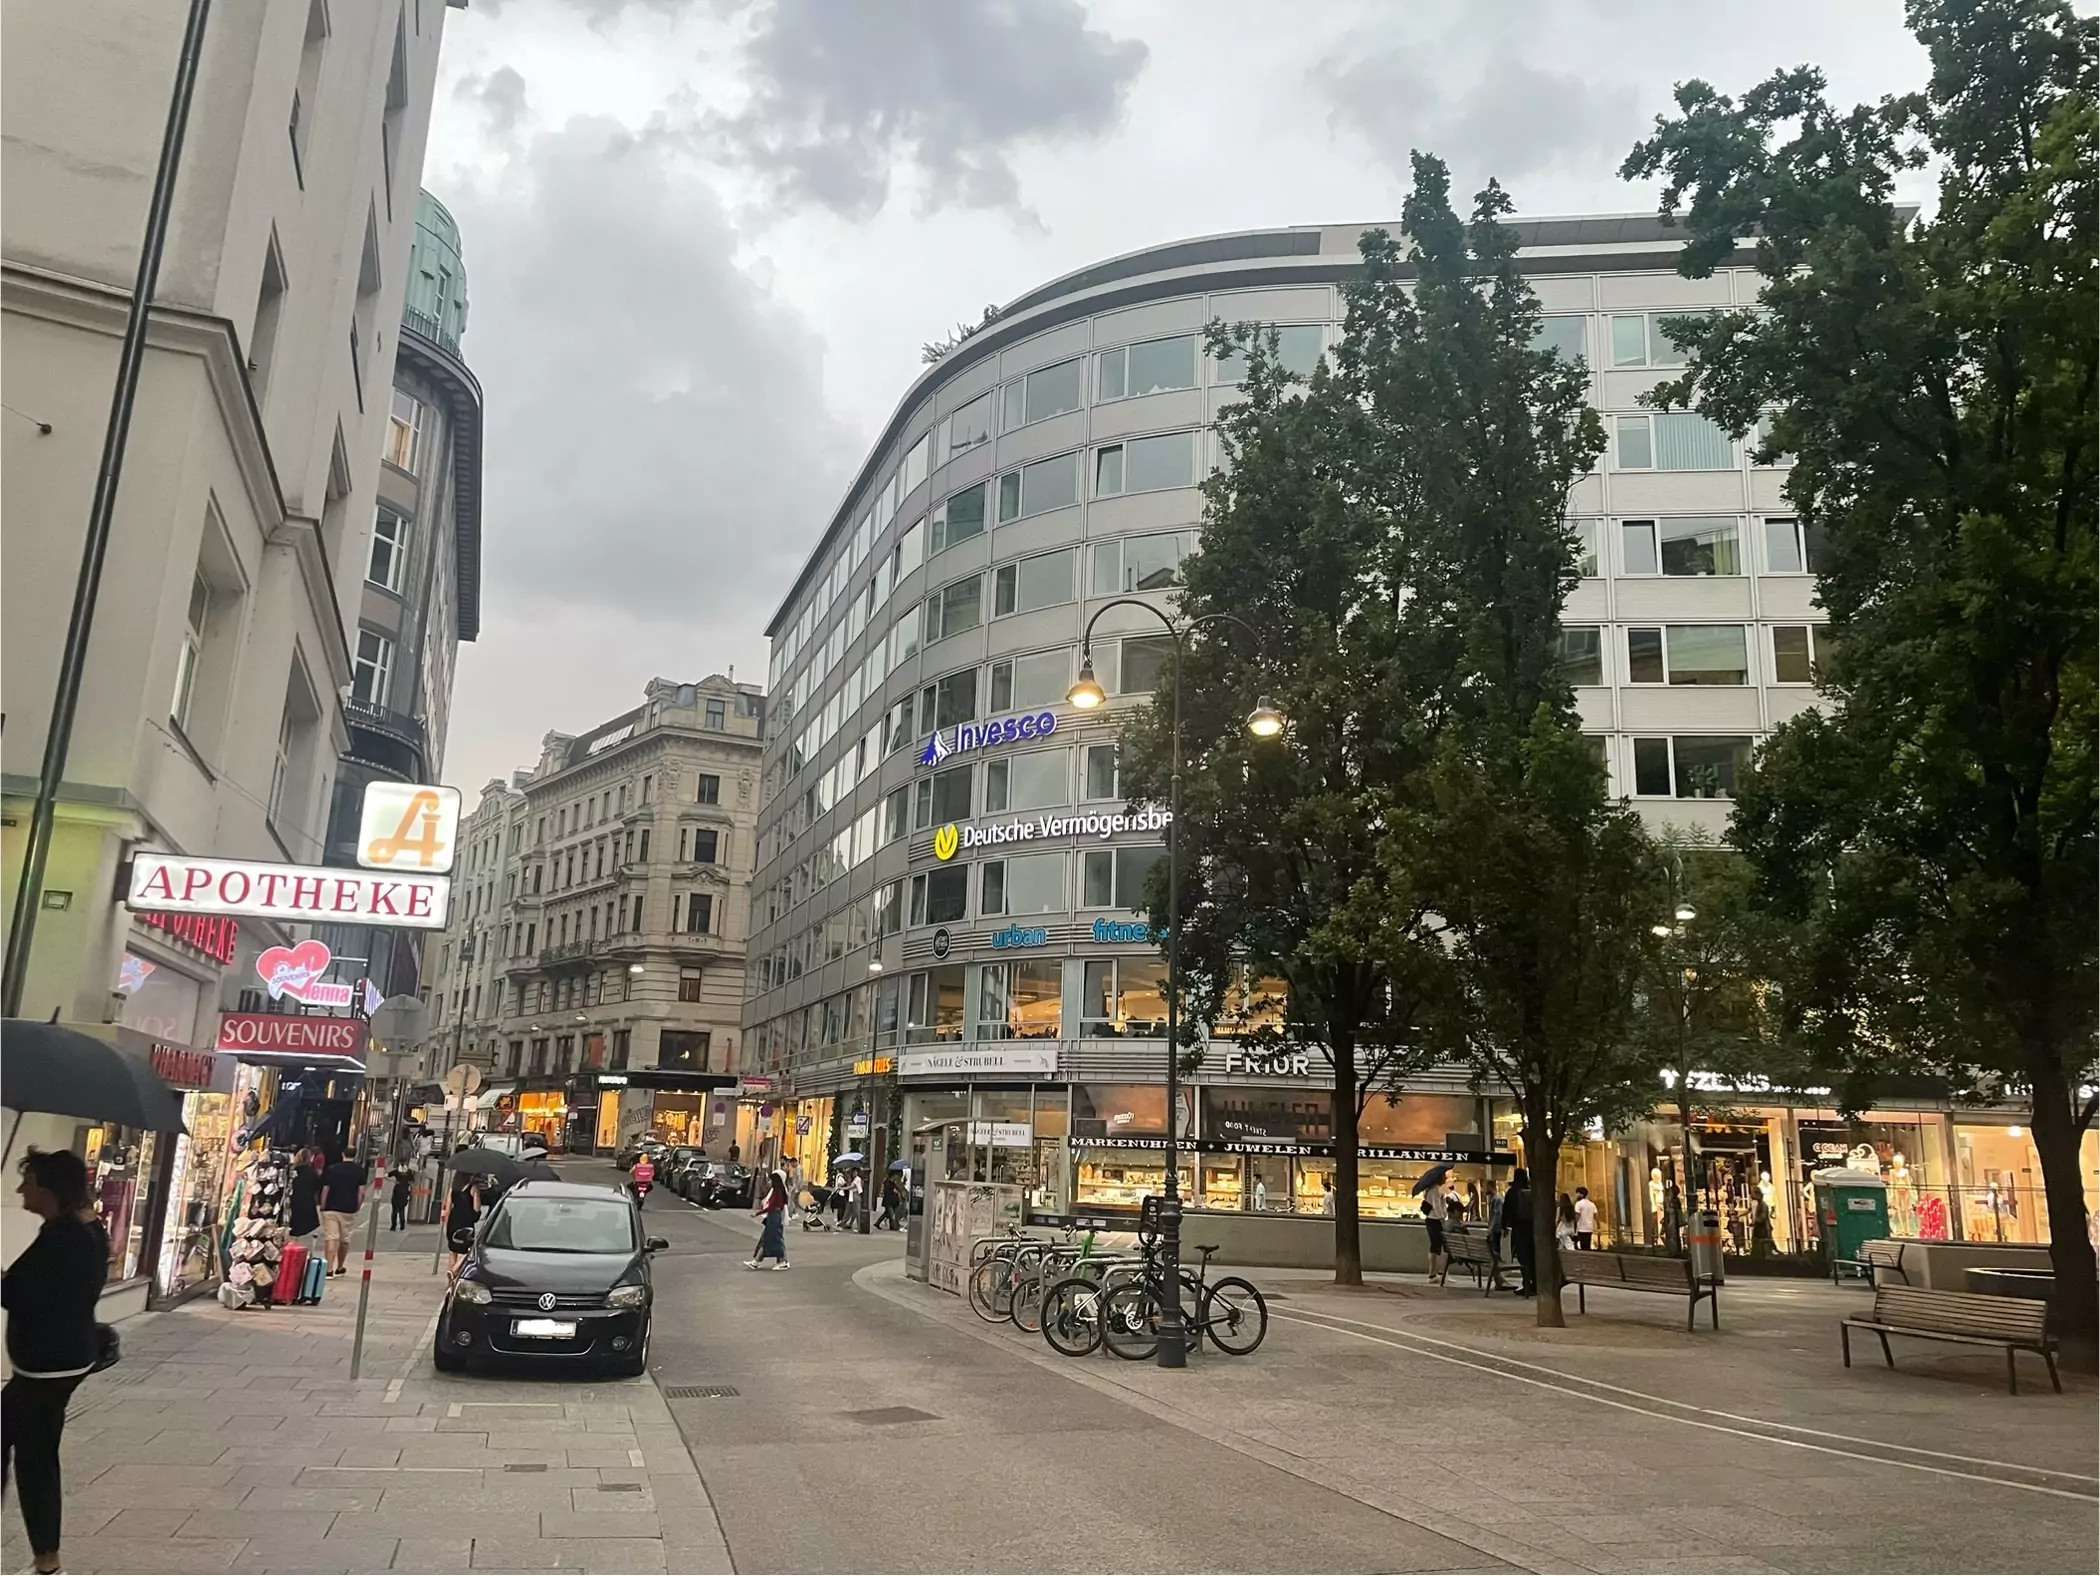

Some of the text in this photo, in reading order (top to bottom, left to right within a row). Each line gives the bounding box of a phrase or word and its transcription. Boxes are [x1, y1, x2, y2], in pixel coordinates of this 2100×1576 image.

[955, 712, 1057, 753] Invesco
[963, 818, 1035, 848] Deutsche
[137, 865, 436, 918] APOTHEKE
[991, 923, 1047, 949] urban
[1093, 917, 1169, 943] fitne
[222, 1018, 355, 1050] SOUVENIRS
[1223, 1142, 1312, 1155] JUWELEN
[1357, 1149, 1470, 1162] RILLANTEN
